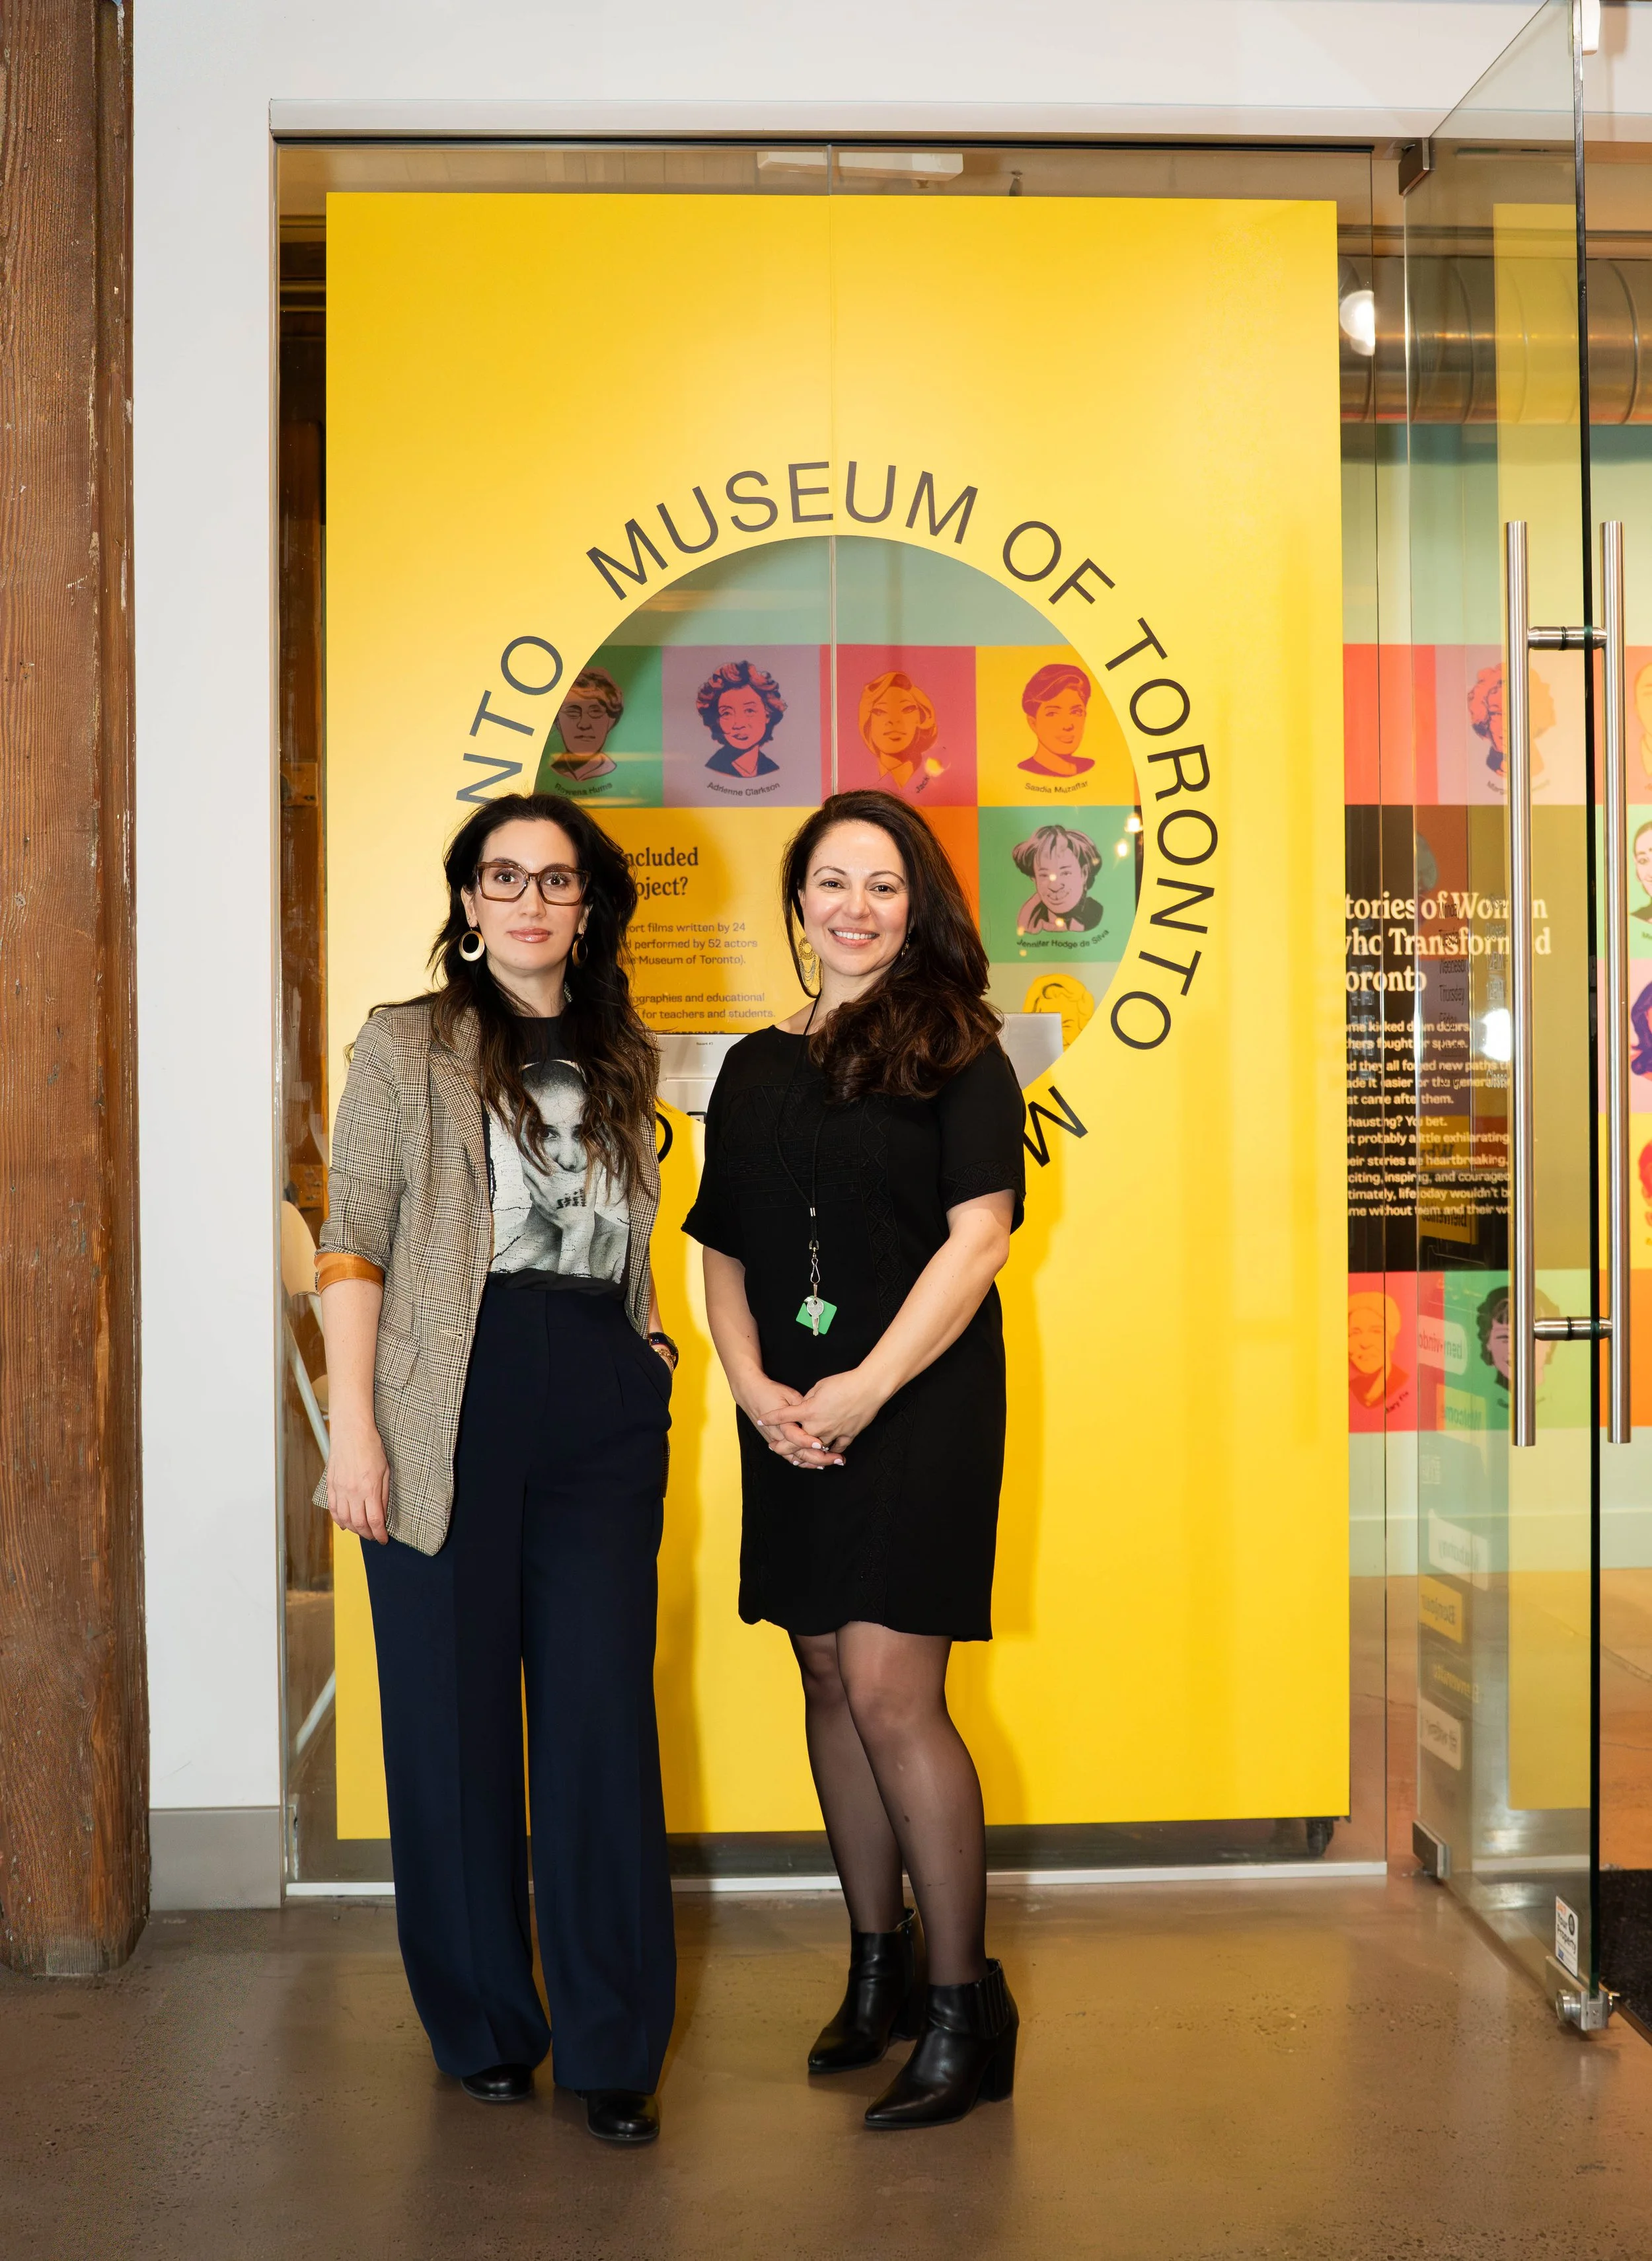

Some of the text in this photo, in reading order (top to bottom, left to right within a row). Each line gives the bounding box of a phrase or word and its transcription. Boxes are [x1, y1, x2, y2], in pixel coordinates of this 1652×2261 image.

[585, 461, 1219, 1051] MUSEUM OF TORONTO
[706, 781, 781, 797] Adrienne Clarkson
[1025, 780, 1089, 794] Saadia Muzaffar
[1421, 891, 1448, 920] of
[1450, 892, 1549, 920] Womn
[648, 922, 673, 933] films
[676, 922, 715, 932] written
[718, 922, 730, 934] by
[732, 922, 746, 932] 24
[634, 939, 691, 951] performed
[693, 939, 704, 950] by
[708, 938, 721, 948] 52
[724, 940, 758, 948] actors
[1016, 939, 1049, 948] Jennifer
[1051, 940, 1078, 949] Hodge
[1091, 929, 1110, 945] Silva
[1388, 926, 1552, 956] Transformd
[639, 955, 683, 965] Museum
[687, 955, 696, 965] of
[700, 954, 746, 966] Toronto).
[1346, 965, 1427, 992] oronto
[685, 992, 704, 1002] and
[706, 992, 765, 1002] educational
[642, 1009, 657, 1019] for
[659, 1008, 705, 1019] teachers
[707, 1008, 726, 1018] and
[728, 1008, 776, 1018] students.
[1386, 1059, 1400, 1071] all
[1402, 1058, 1437, 1073] foged
[1439, 1061, 1464, 1071] new
[1464, 1060, 1497, 1073] paths
[1393, 1092, 1417, 1105] afte
[1421, 1093, 1454, 1105] them.
[1347, 1115, 1404, 1130] haustng?
[1425, 1116, 1448, 1127] bet.
[1384, 1171, 1432, 1185] inspirng,
[1435, 1169, 1456, 1182] and
[1398, 1187, 1417, 1199] life
[1420, 1187, 1447, 1201] oday
